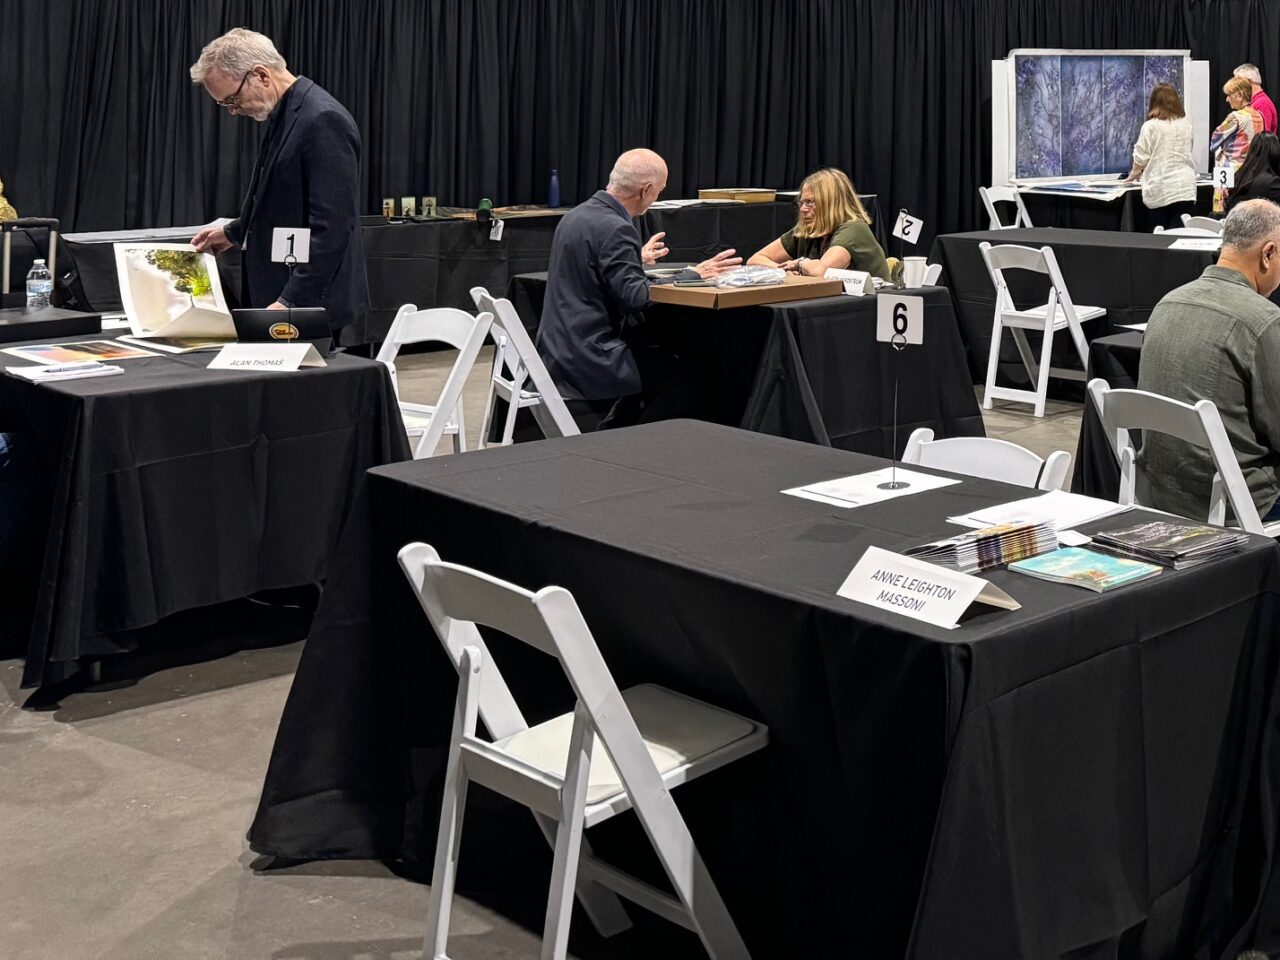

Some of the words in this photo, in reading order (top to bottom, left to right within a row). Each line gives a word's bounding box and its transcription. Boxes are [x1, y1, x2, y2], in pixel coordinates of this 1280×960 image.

[1219, 170, 1227, 184] 3
[901, 219, 914, 236] 2
[286, 233, 295, 256] 1
[892, 302, 908, 335] 6
[252, 358, 284, 366] THOMAS
[870, 569, 904, 587] ANNE
[901, 576, 957, 601] LEIGHTON
[876, 589, 927, 612] MASSONI
